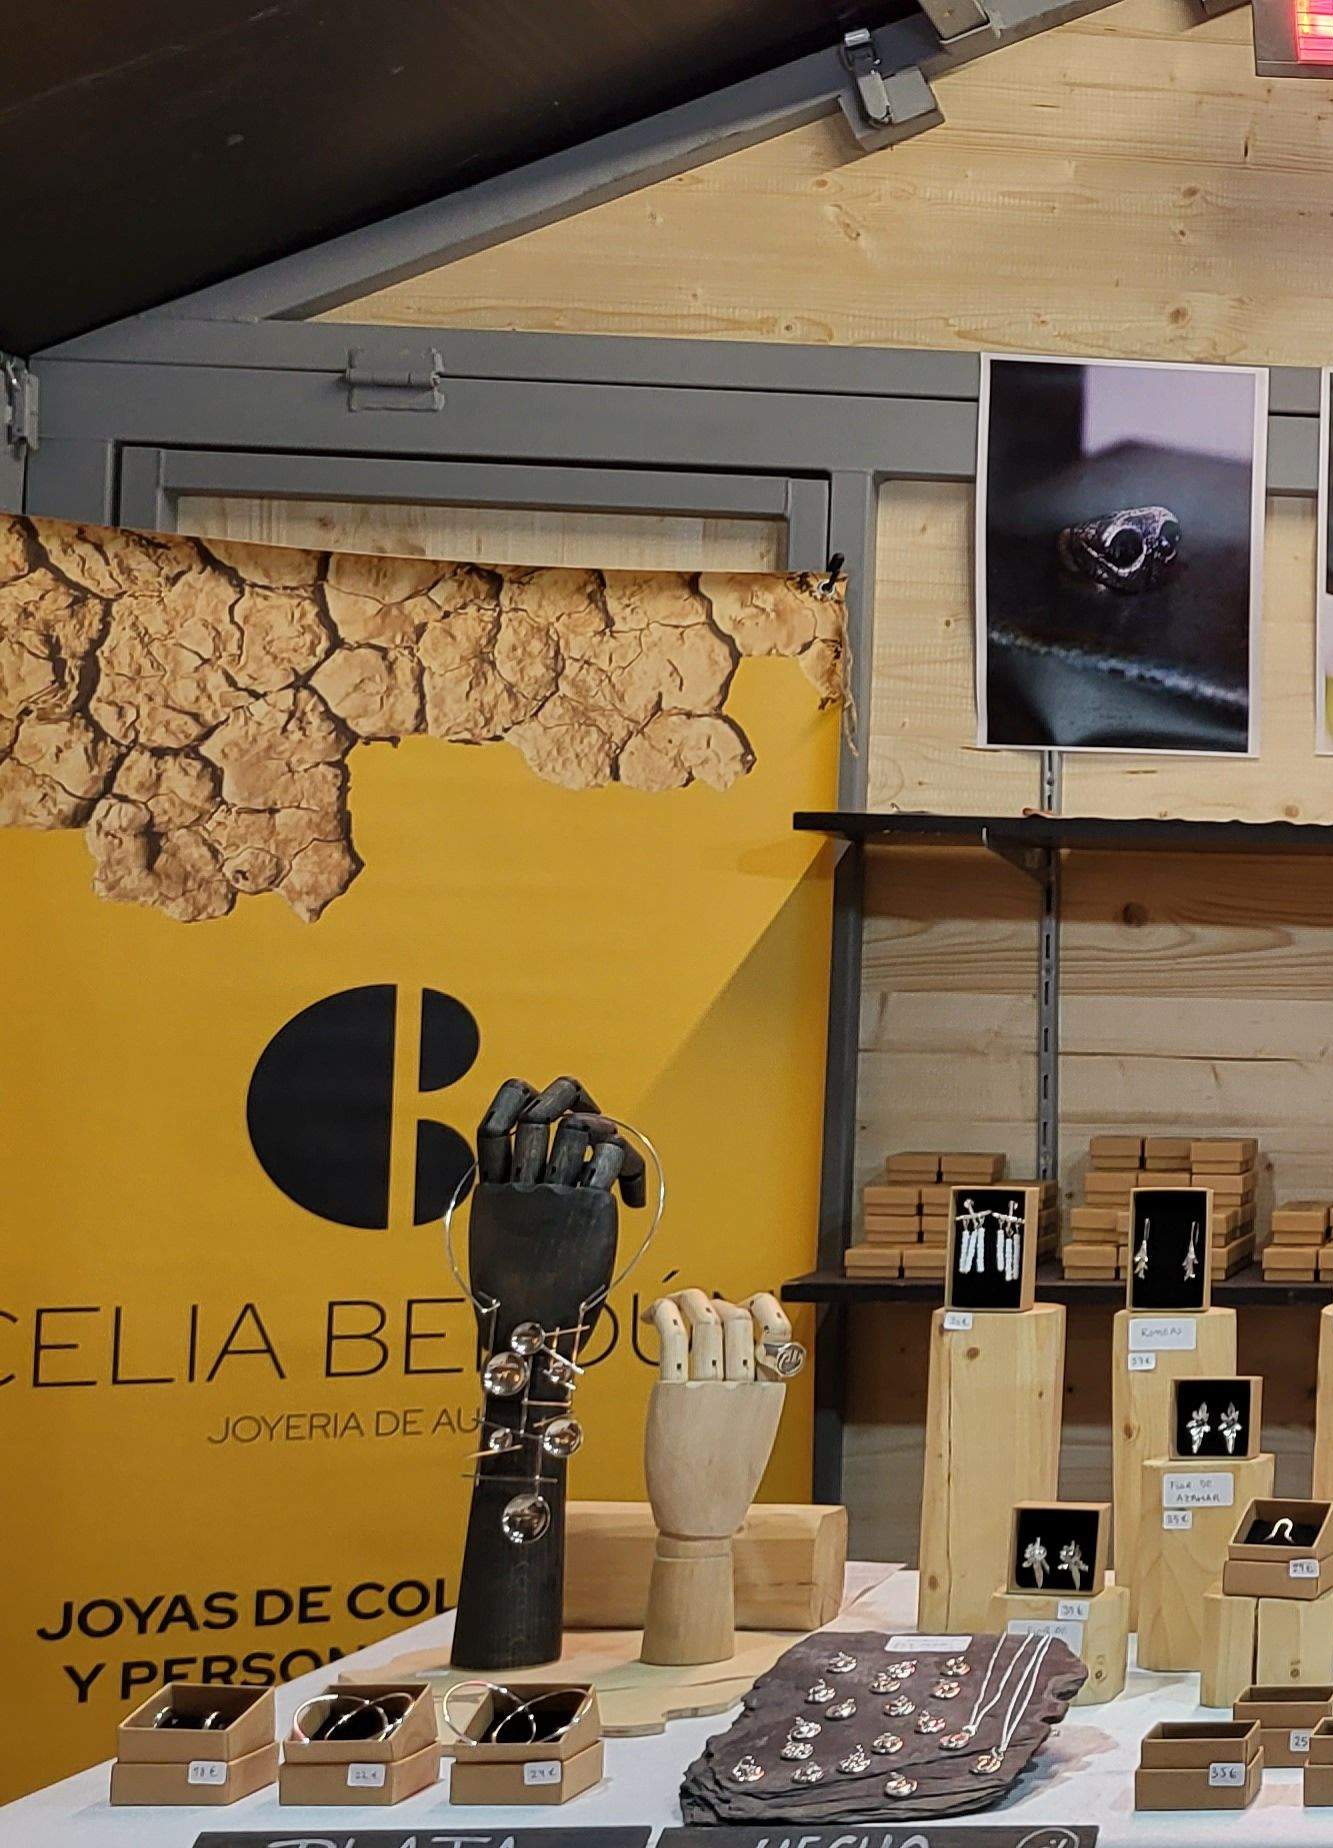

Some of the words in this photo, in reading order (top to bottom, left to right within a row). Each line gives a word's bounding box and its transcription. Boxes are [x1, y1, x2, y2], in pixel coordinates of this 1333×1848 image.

[207, 1411, 365, 1445] JOYERIA
[375, 1409, 423, 1437] DE
[36, 1591, 239, 1641] JOYAS
[255, 1585, 332, 1628] DE
[346, 1578, 457, 1621] COL
[63, 1663, 107, 1704] Y
[1210, 1766, 1238, 1780] 35€
